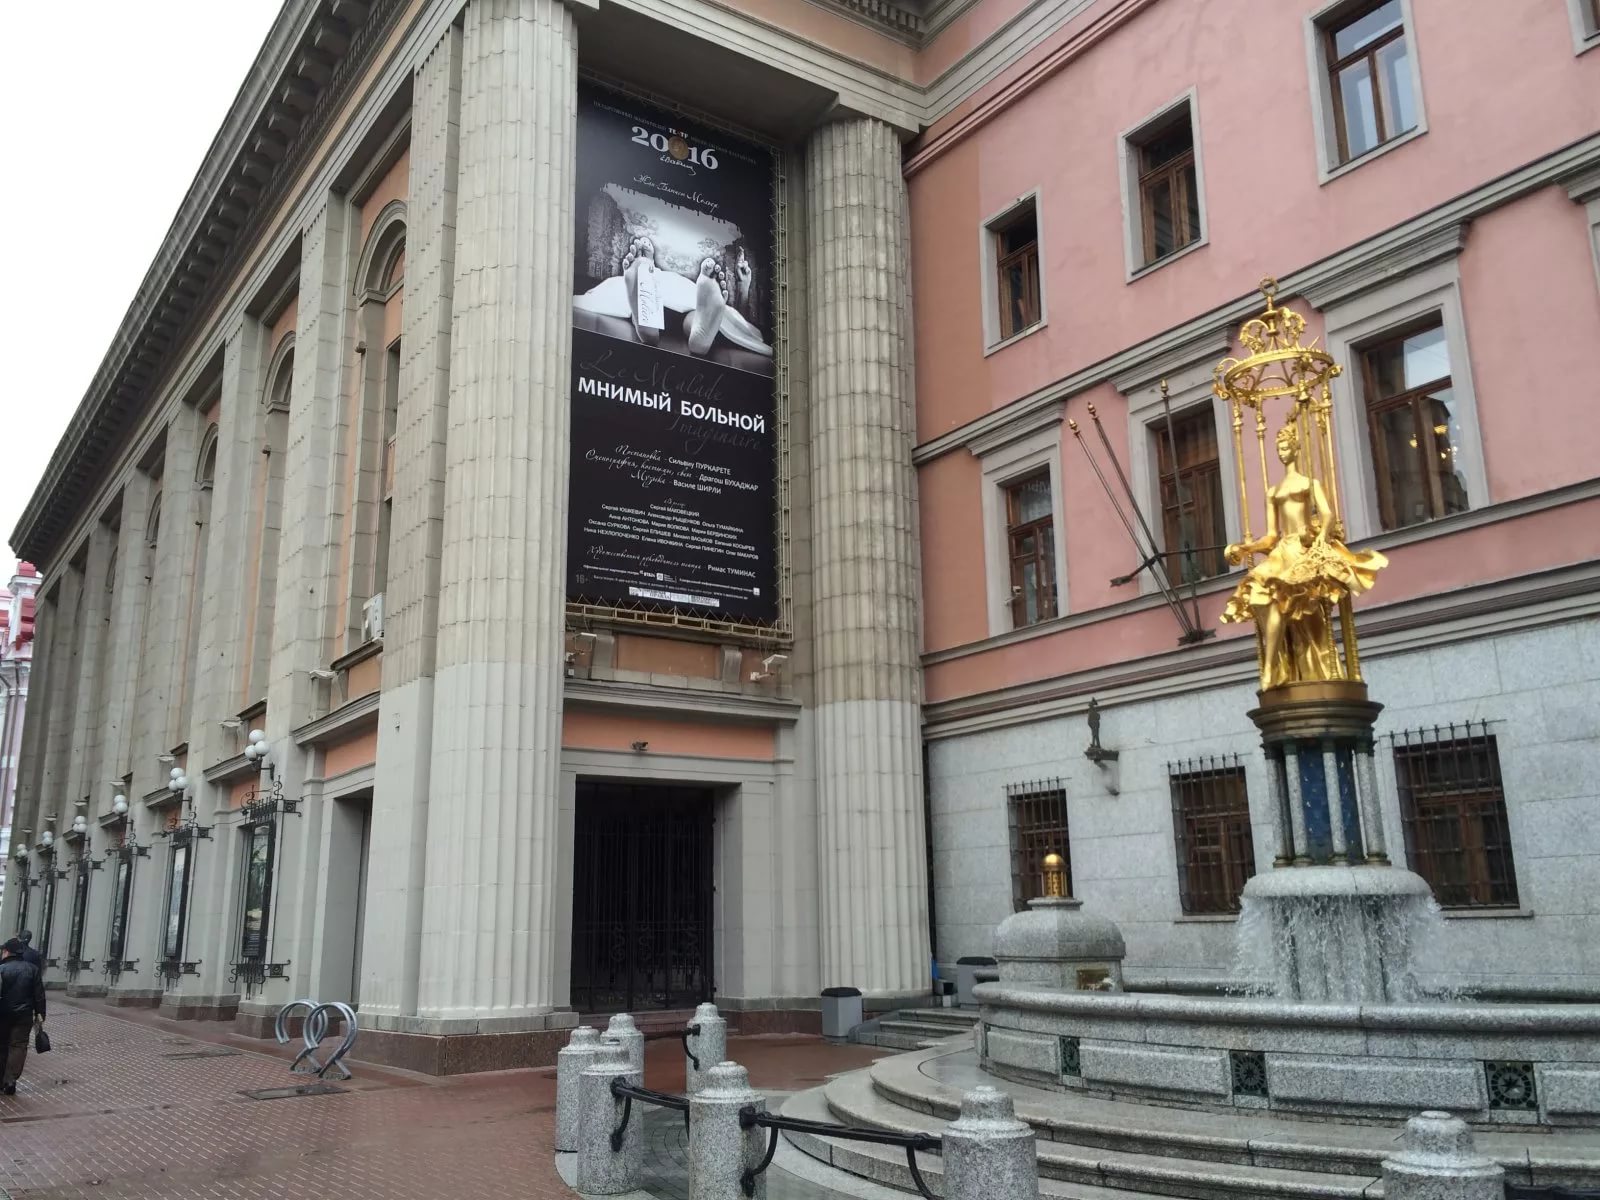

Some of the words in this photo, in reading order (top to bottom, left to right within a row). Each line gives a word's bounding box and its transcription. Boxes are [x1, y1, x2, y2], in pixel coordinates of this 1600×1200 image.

[578, 376, 672, 412] МНИМЫЙ
[680, 400, 765, 434] БОЛЬНОЙ
[668, 456, 694, 469] Сильвиу
[695, 462, 731, 476] ПУРКАРЕТЕ
[673, 480, 696, 490] Василе
[697, 484, 722, 495] ШИРЛИ
[698, 473, 724, 485] Драгош
[724, 479, 759, 491] БУХАДЖАР
[707, 564, 727, 575] Римас
[727, 567, 757, 578] ТУМИНАС
